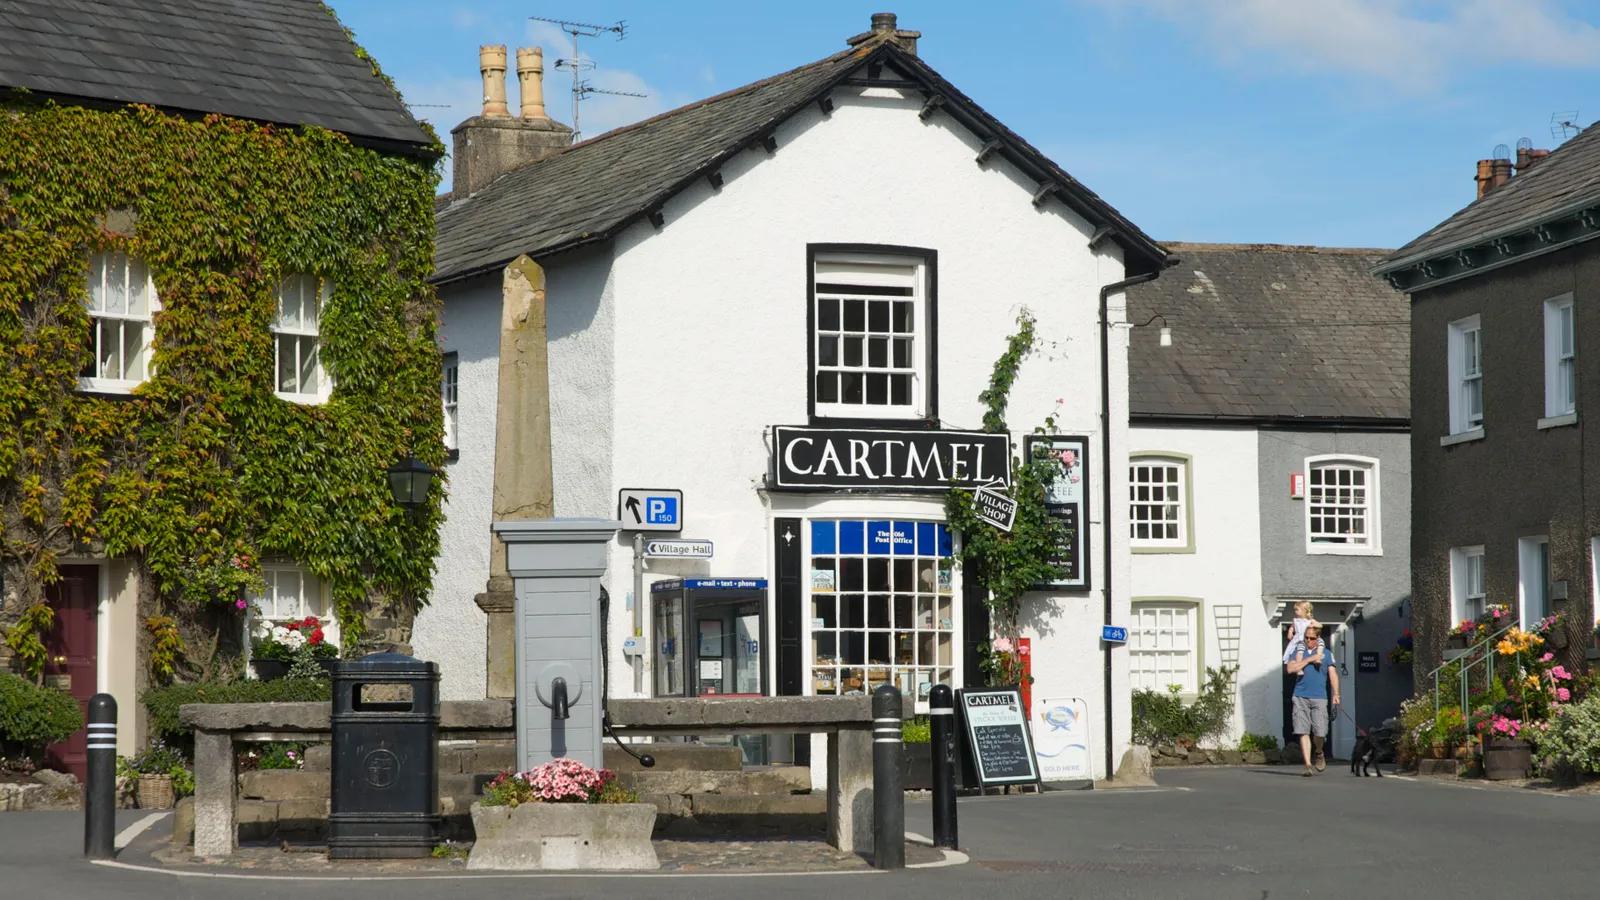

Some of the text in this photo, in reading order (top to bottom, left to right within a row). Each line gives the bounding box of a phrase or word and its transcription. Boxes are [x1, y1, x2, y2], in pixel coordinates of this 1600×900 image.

[784, 437, 995, 482] CARTMEL
[650, 500, 672, 522] P 150
[979, 492, 1014, 514] VILLAGE
[983, 505, 1007, 521] SHOP
[658, 544, 711, 555] Village Hall
[968, 695, 1012, 706] CARTMEL
